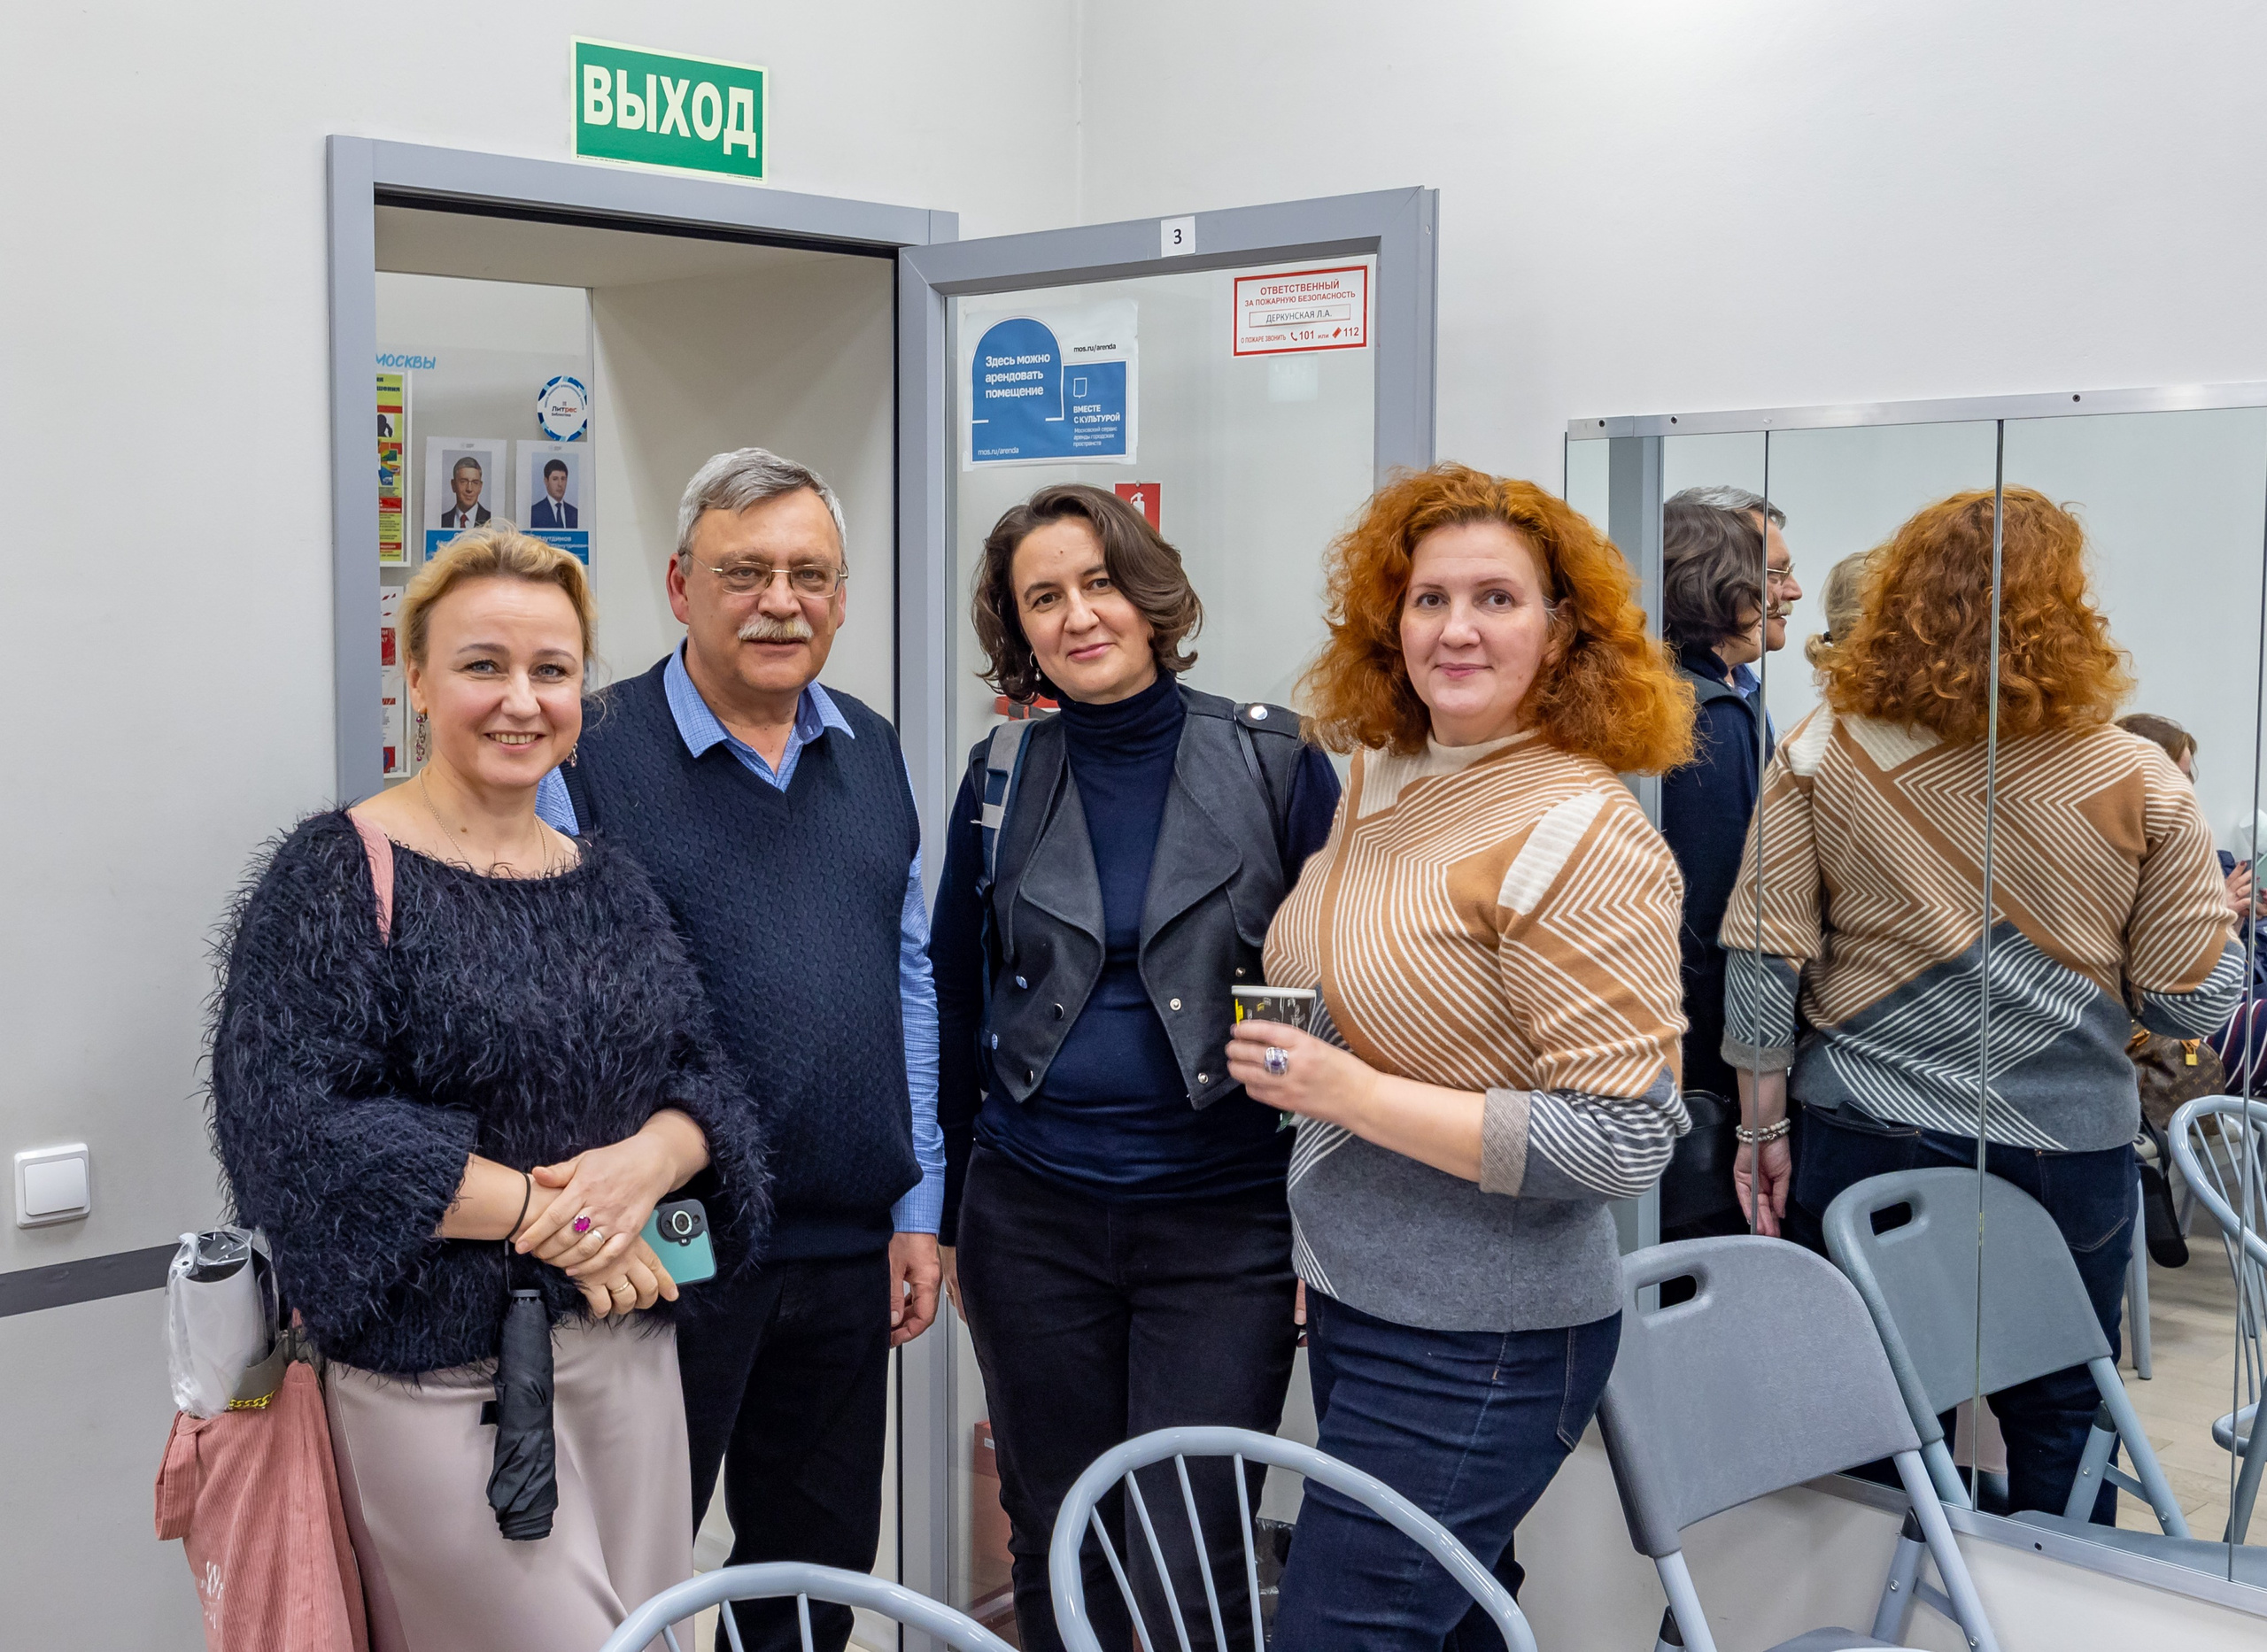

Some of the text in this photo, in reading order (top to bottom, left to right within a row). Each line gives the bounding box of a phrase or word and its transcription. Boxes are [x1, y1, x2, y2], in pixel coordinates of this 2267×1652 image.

[583, 64, 756, 158] ВЫХОД
[1173, 228, 1182, 244] 3
[1260, 278, 1340, 296] ОТВЕТСТВЕННЫЙ
[1255, 296, 1296, 306] ПОЖАРНУЮ
[1297, 290, 1356, 302] БЕЗОПАСНОСТЬ
[1265, 309, 1332, 323] ДЕРКУНСКАЯ Л.А.
[1265, 334, 1287, 343] ЗВОНИТЬ
[1299, 330, 1314, 341] 101
[1343, 327, 1359, 337] 112
[1073, 343, 1117, 352] mos.ru/arenda
[375, 353, 436, 369] МОСКВЫ
[985, 353, 1051, 368] Здесь можно
[985, 370, 1044, 385] арендовать
[985, 386, 1044, 398] помещение
[1072, 404, 1102, 413] ВМЕСТЕ
[1073, 412, 1121, 424] С КУЛЬТУРОЙ
[977, 446, 1019, 456] mos.ru/arenda
